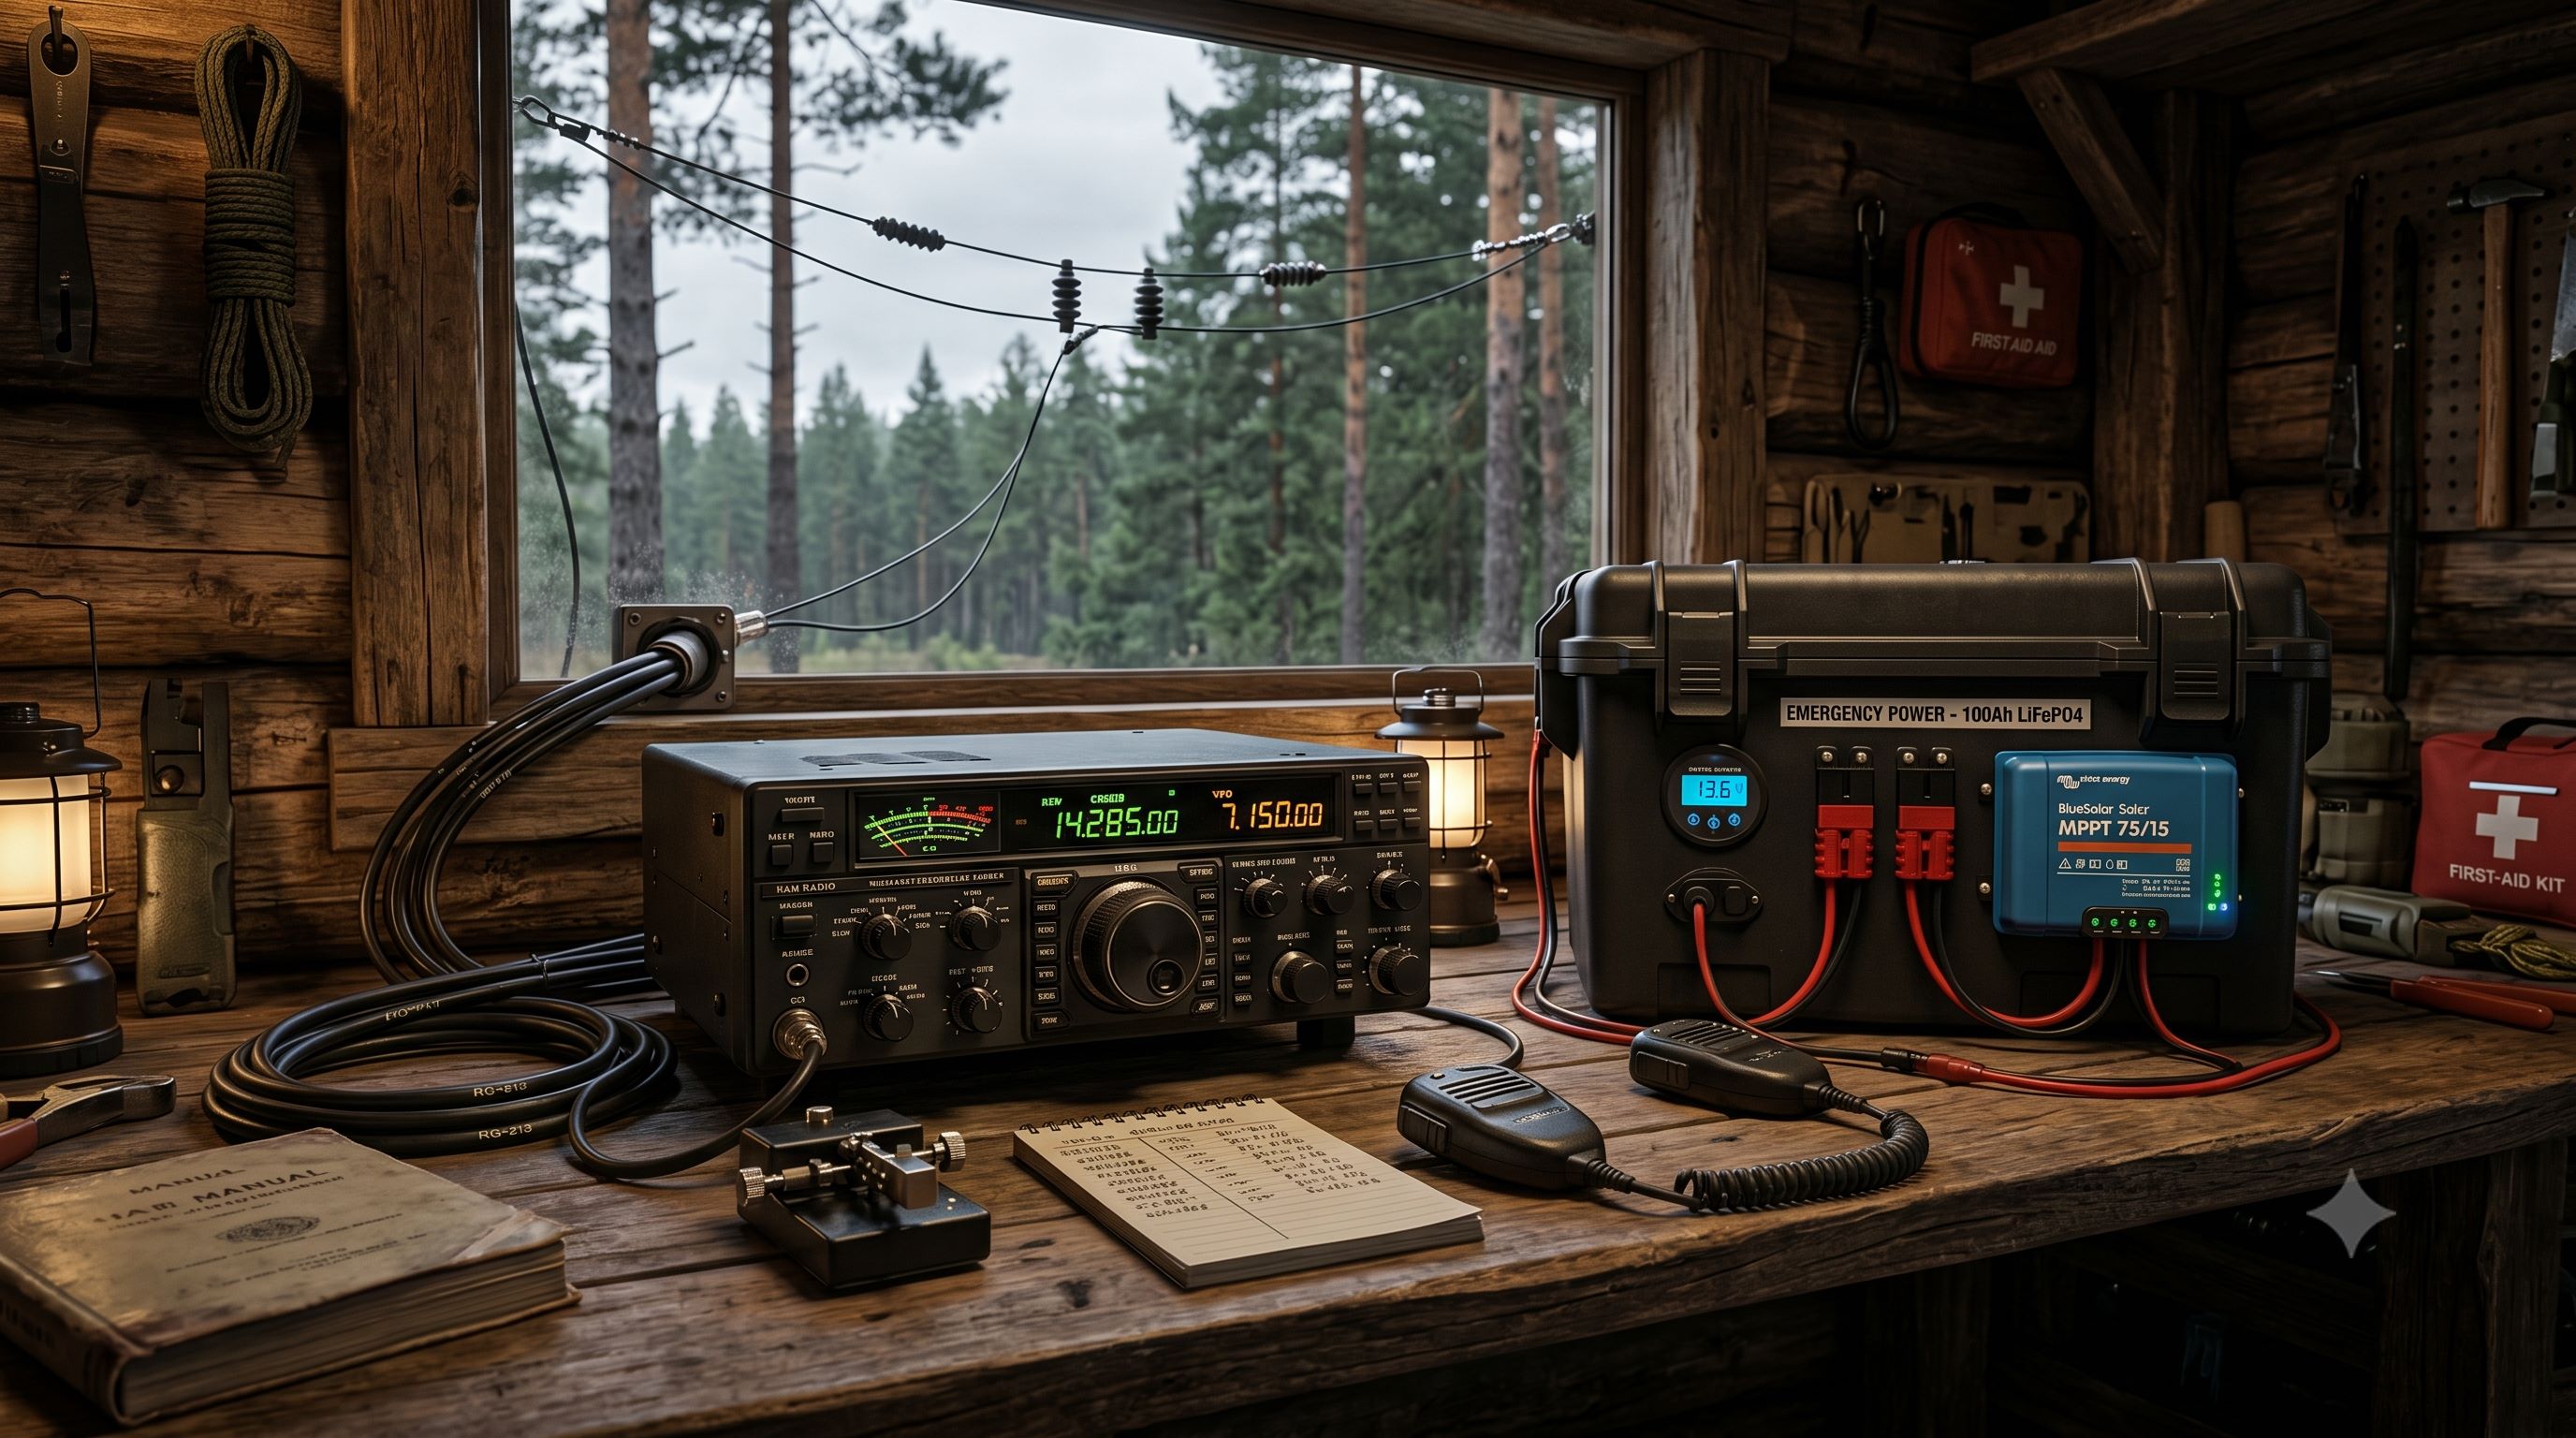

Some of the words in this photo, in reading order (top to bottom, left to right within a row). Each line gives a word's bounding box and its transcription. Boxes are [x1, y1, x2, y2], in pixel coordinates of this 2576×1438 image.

[1971, 331, 2011, 351] FIRST
[2010, 335, 2034, 353] AID
[2034, 340, 2057, 356] AID
[1786, 704, 1883, 722] EMERGENCY
[1888, 706, 1945, 722] POWER
[1962, 706, 2012, 723] 100Ah
[2017, 706, 2084, 724] LiFePO4
[1699, 780, 1731, 799] 13.6
[2058, 802, 2115, 814] BlueSolar
[1056, 806, 1178, 839] 14.285.00
[2058, 819, 2113, 836] MPPT
[2116, 820, 2170, 837] 75/15
[2449, 863, 2531, 889] FIRST-AID
[2536, 875, 2566, 893] KIT
[776, 884, 799, 894] HAM
[802, 882, 836, 892] RADIO
[478, 1123, 533, 1140] RG-213
[192, 1169, 329, 1203] MANUAL
